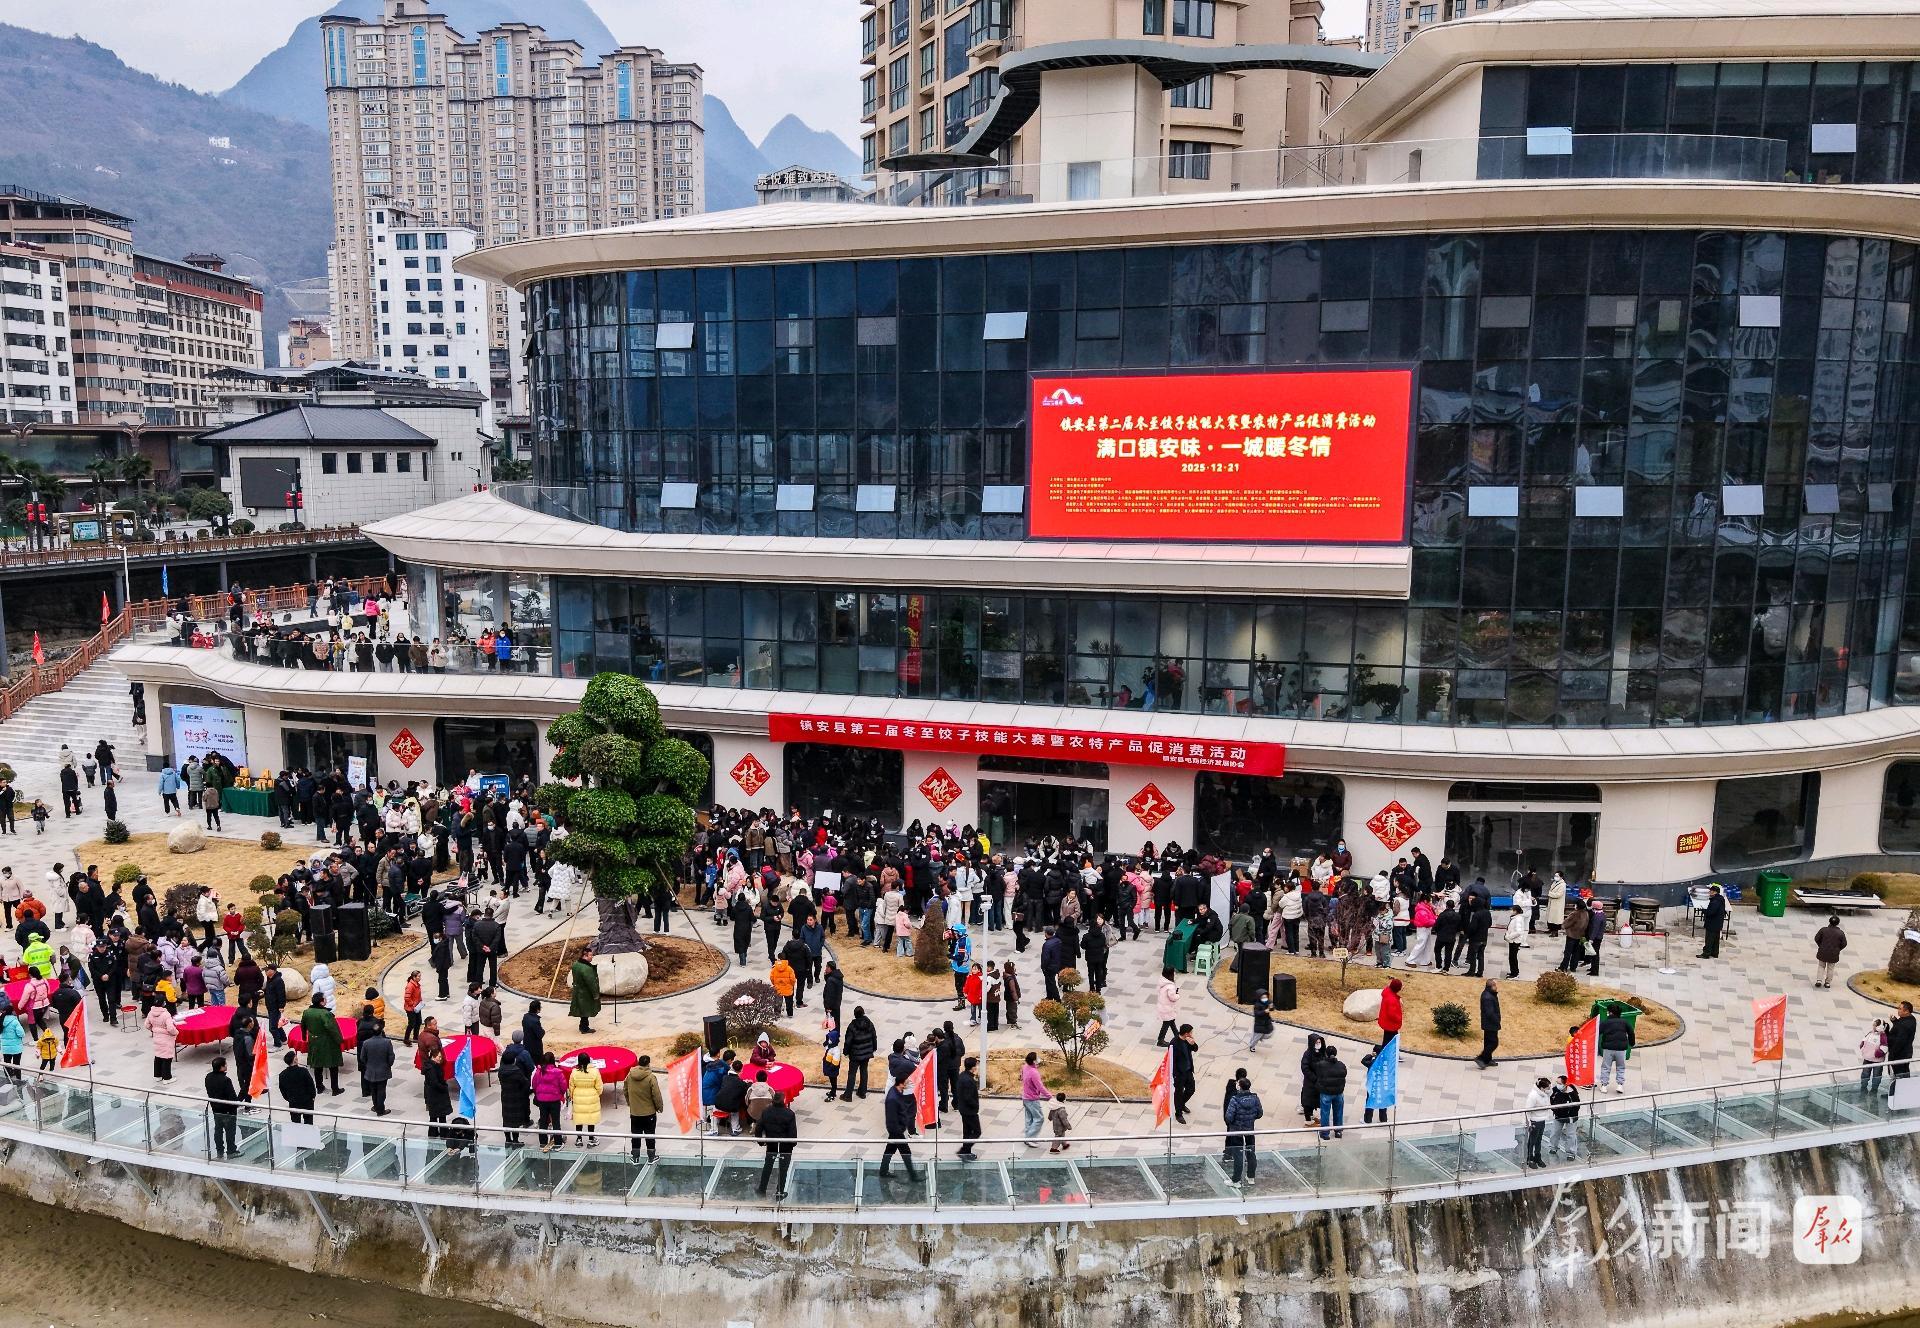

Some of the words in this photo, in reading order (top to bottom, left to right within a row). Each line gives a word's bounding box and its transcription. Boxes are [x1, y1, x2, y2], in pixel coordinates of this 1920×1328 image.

[1059, 411, 1377, 432] 镇安县第二届冬至饺子技能大赛暨农特产品促消费活动
[799, 718, 1248, 761] 镇安县第二届冬至饺子技能大赛暨农特产品促消费活动
[1135, 793, 1165, 819] 大
[1379, 810, 1408, 839] 赛
[1679, 834, 1704, 846] 会场出口
